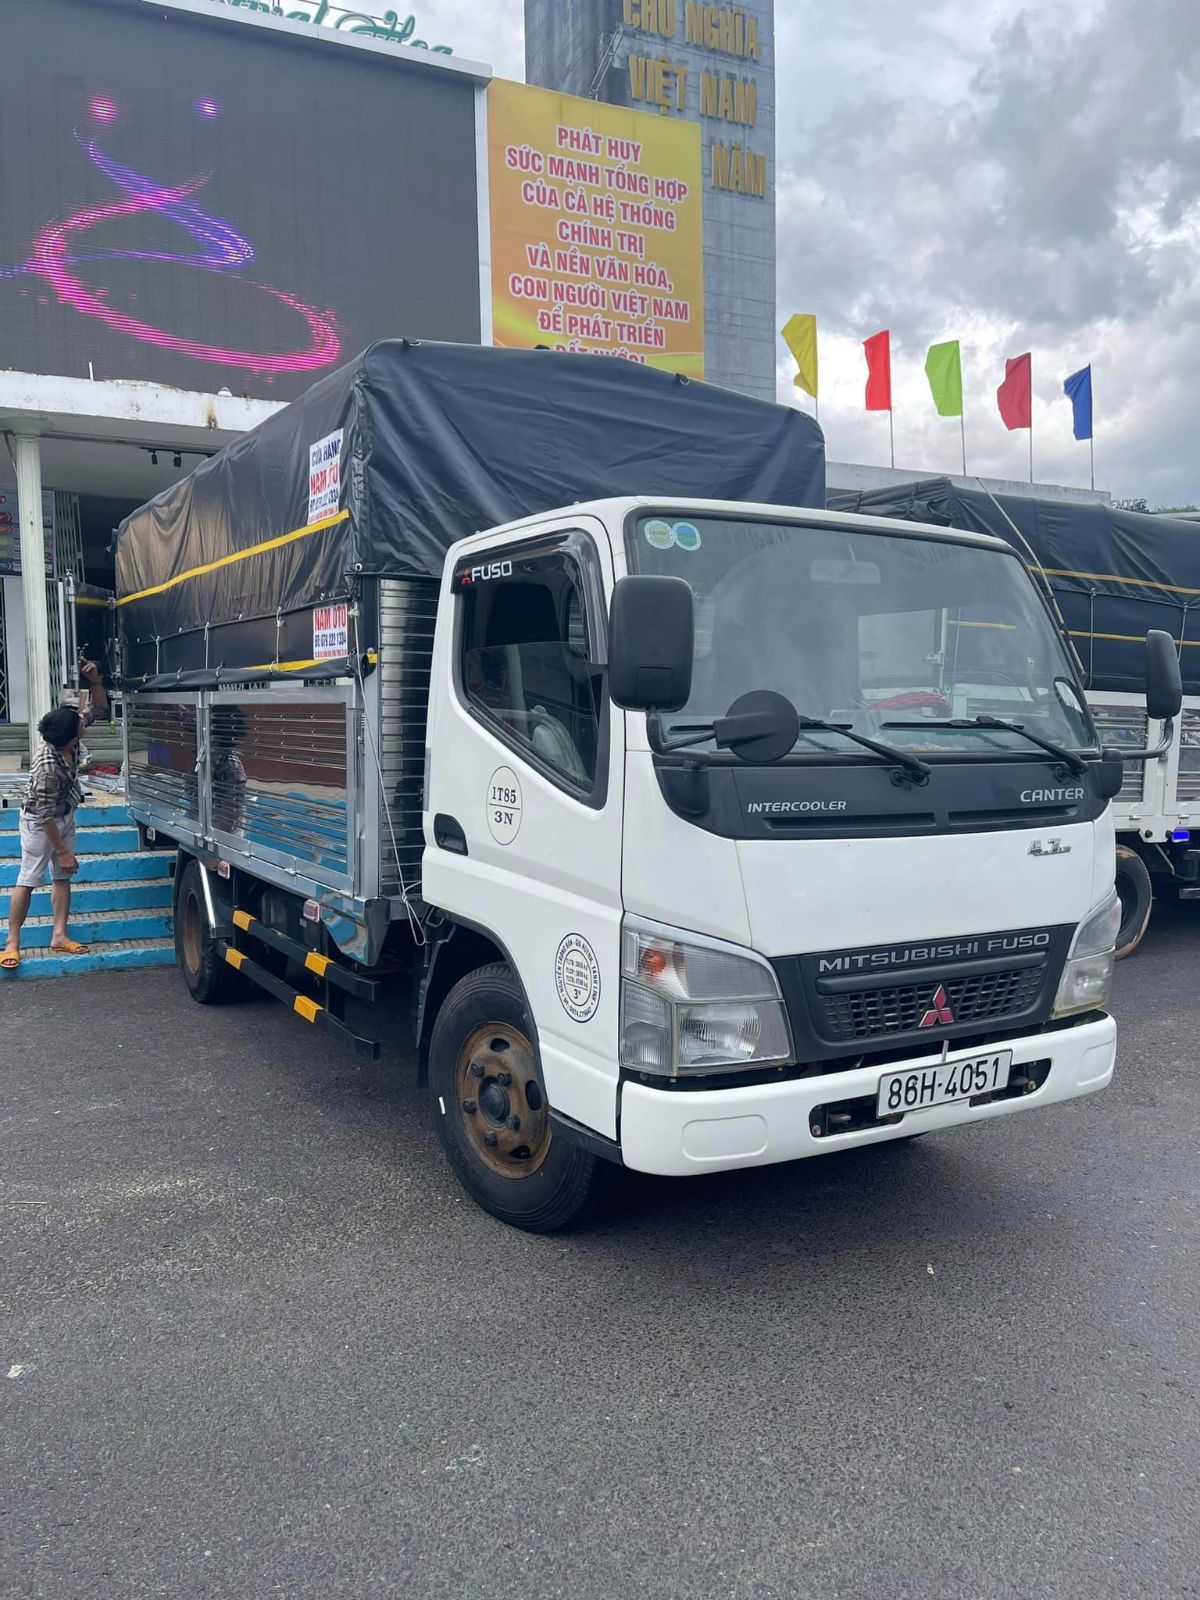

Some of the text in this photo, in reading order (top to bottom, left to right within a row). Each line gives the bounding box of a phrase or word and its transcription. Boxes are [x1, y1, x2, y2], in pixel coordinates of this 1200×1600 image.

[684, 3, 760, 62] NGHĨA
[629, 53, 757, 127] VIỆT NAM
[557, 127, 641, 162] PHÁT HUY
[507, 145, 687, 204] SỨC MẠNH TỔNG HỢP
[711, 140, 766, 198] NĂM
[523, 180, 675, 230] CỦA CẢ HỆ THỐNG
[558, 220, 644, 258] CHÍNH TRỊ
[527, 243, 673, 292] VÀ NỀN VĂN HÓA,
[511, 276, 688, 321] CON NGƯỜI VIỆT NAM
[539, 306, 562, 331] ĐỂ
[568, 315, 612, 338] PHÁT
[617, 320, 664, 347] TRIỂN
[471, 560, 512, 582] FUSO
[315, 608, 331, 631] NAM
[492, 786, 517, 804] 1T85
[747, 800, 847, 813] INTERCOOLER
[1020, 788, 1085, 802] CANTER
[818, 932, 1051, 973] MITSUBISHI FUSO
[888, 1056, 1000, 1111] 86H-4051
